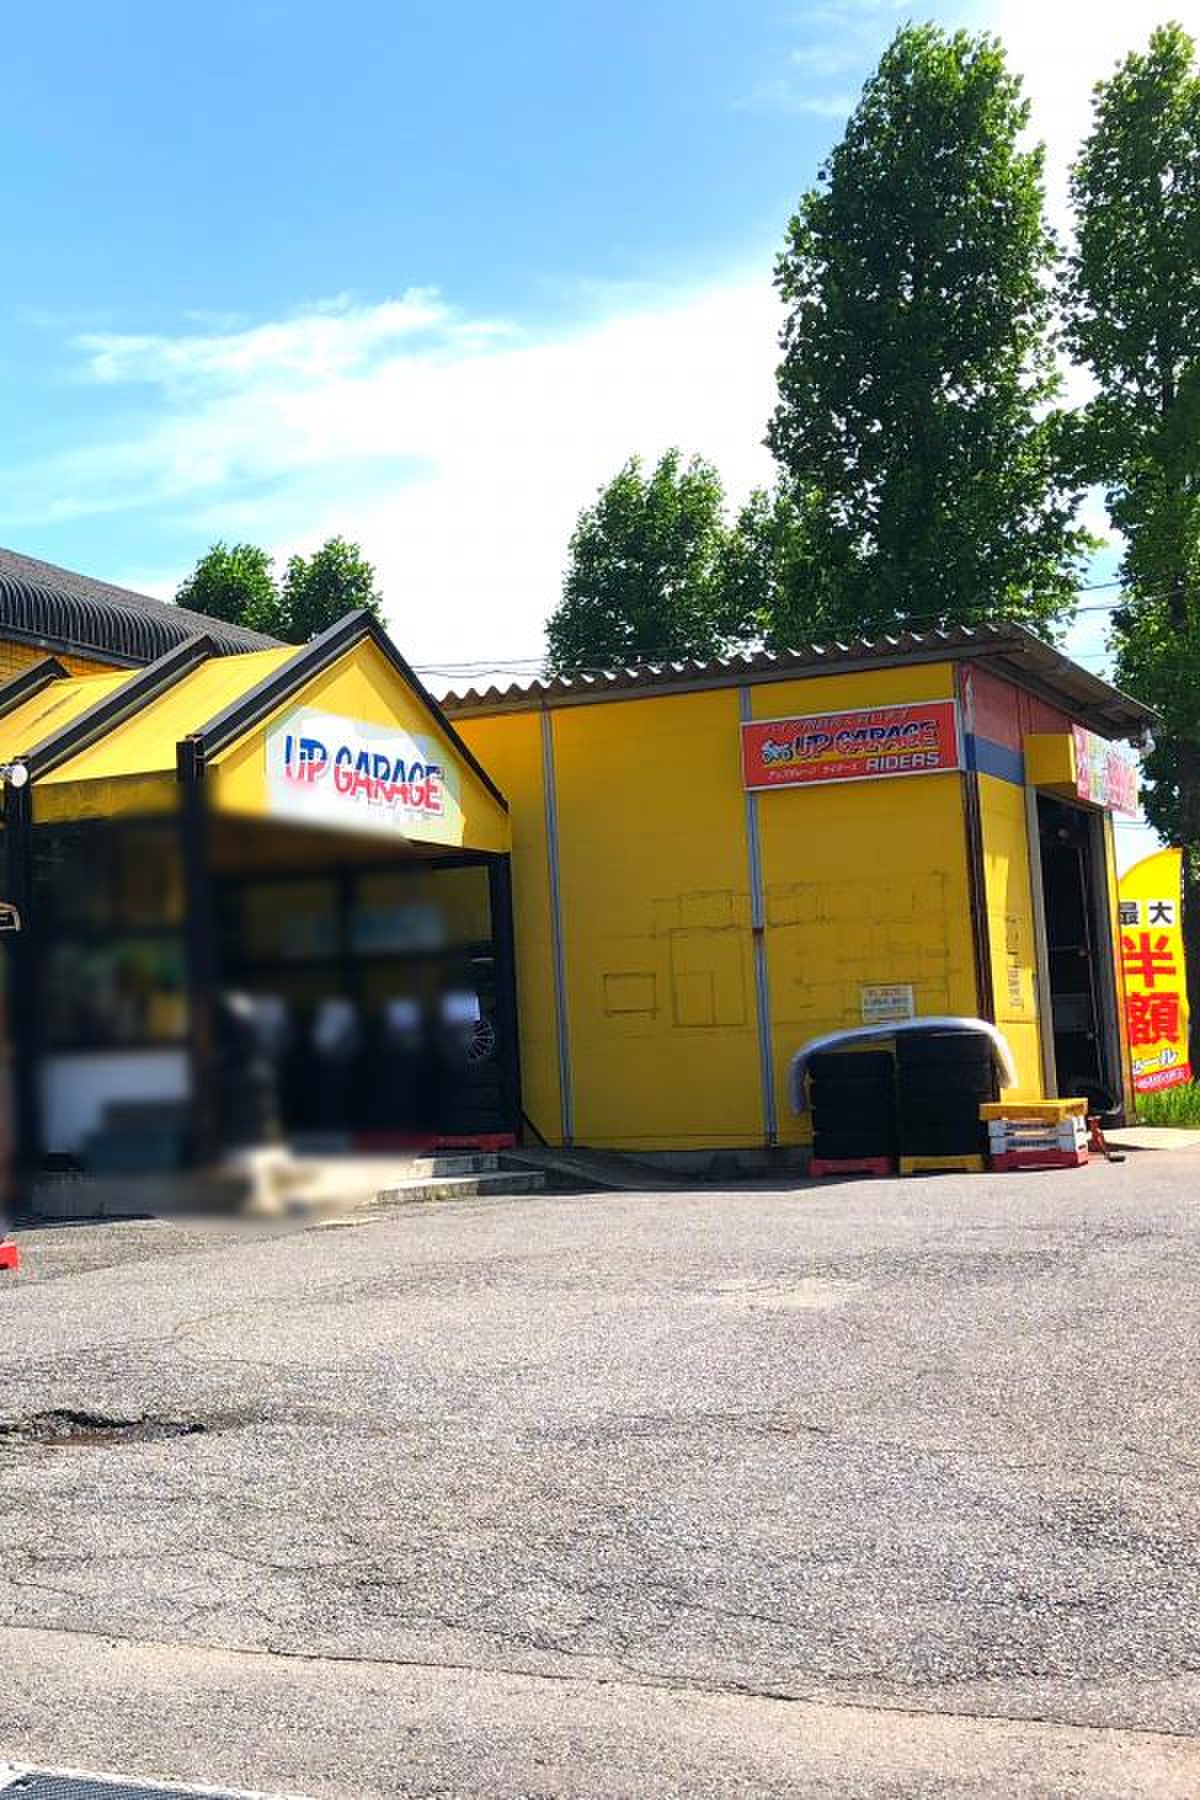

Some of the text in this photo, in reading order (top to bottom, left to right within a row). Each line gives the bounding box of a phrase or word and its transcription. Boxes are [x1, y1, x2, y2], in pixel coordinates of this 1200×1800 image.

[794, 721, 940, 760] UP GARAGE
[284, 735, 443, 813] UP GARAGE
[865, 751, 941, 771] RIDERS
